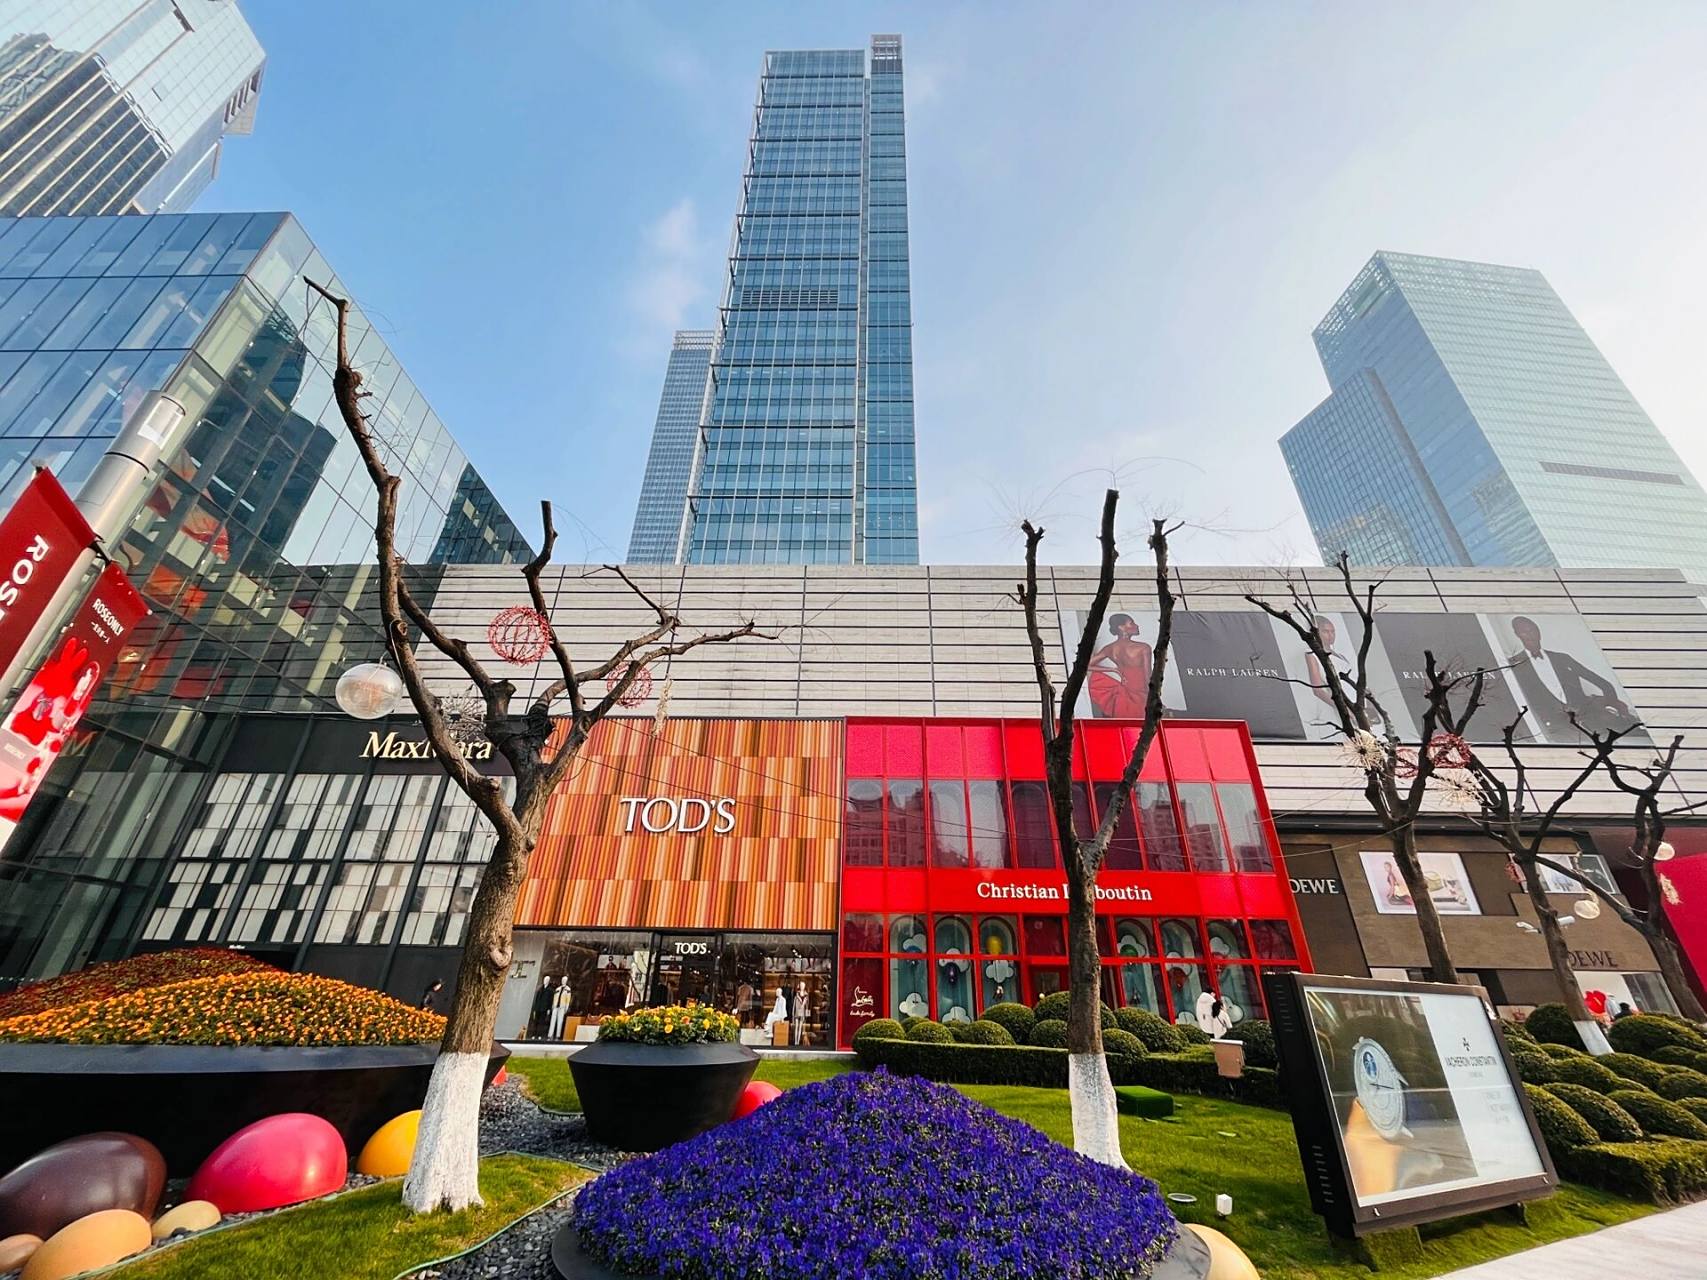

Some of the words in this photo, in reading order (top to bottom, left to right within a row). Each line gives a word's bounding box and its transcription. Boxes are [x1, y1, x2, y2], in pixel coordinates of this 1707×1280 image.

[0, 534, 50, 621] ROS
[92, 598, 125, 636] ROSEONLY
[1186, 667, 1227, 677] RALPH
[1231, 667, 1280, 677] LAUREN
[620, 797, 736, 833] TOD'S
[976, 882, 1060, 900] Christian
[1289, 878, 1340, 894] OEWE
